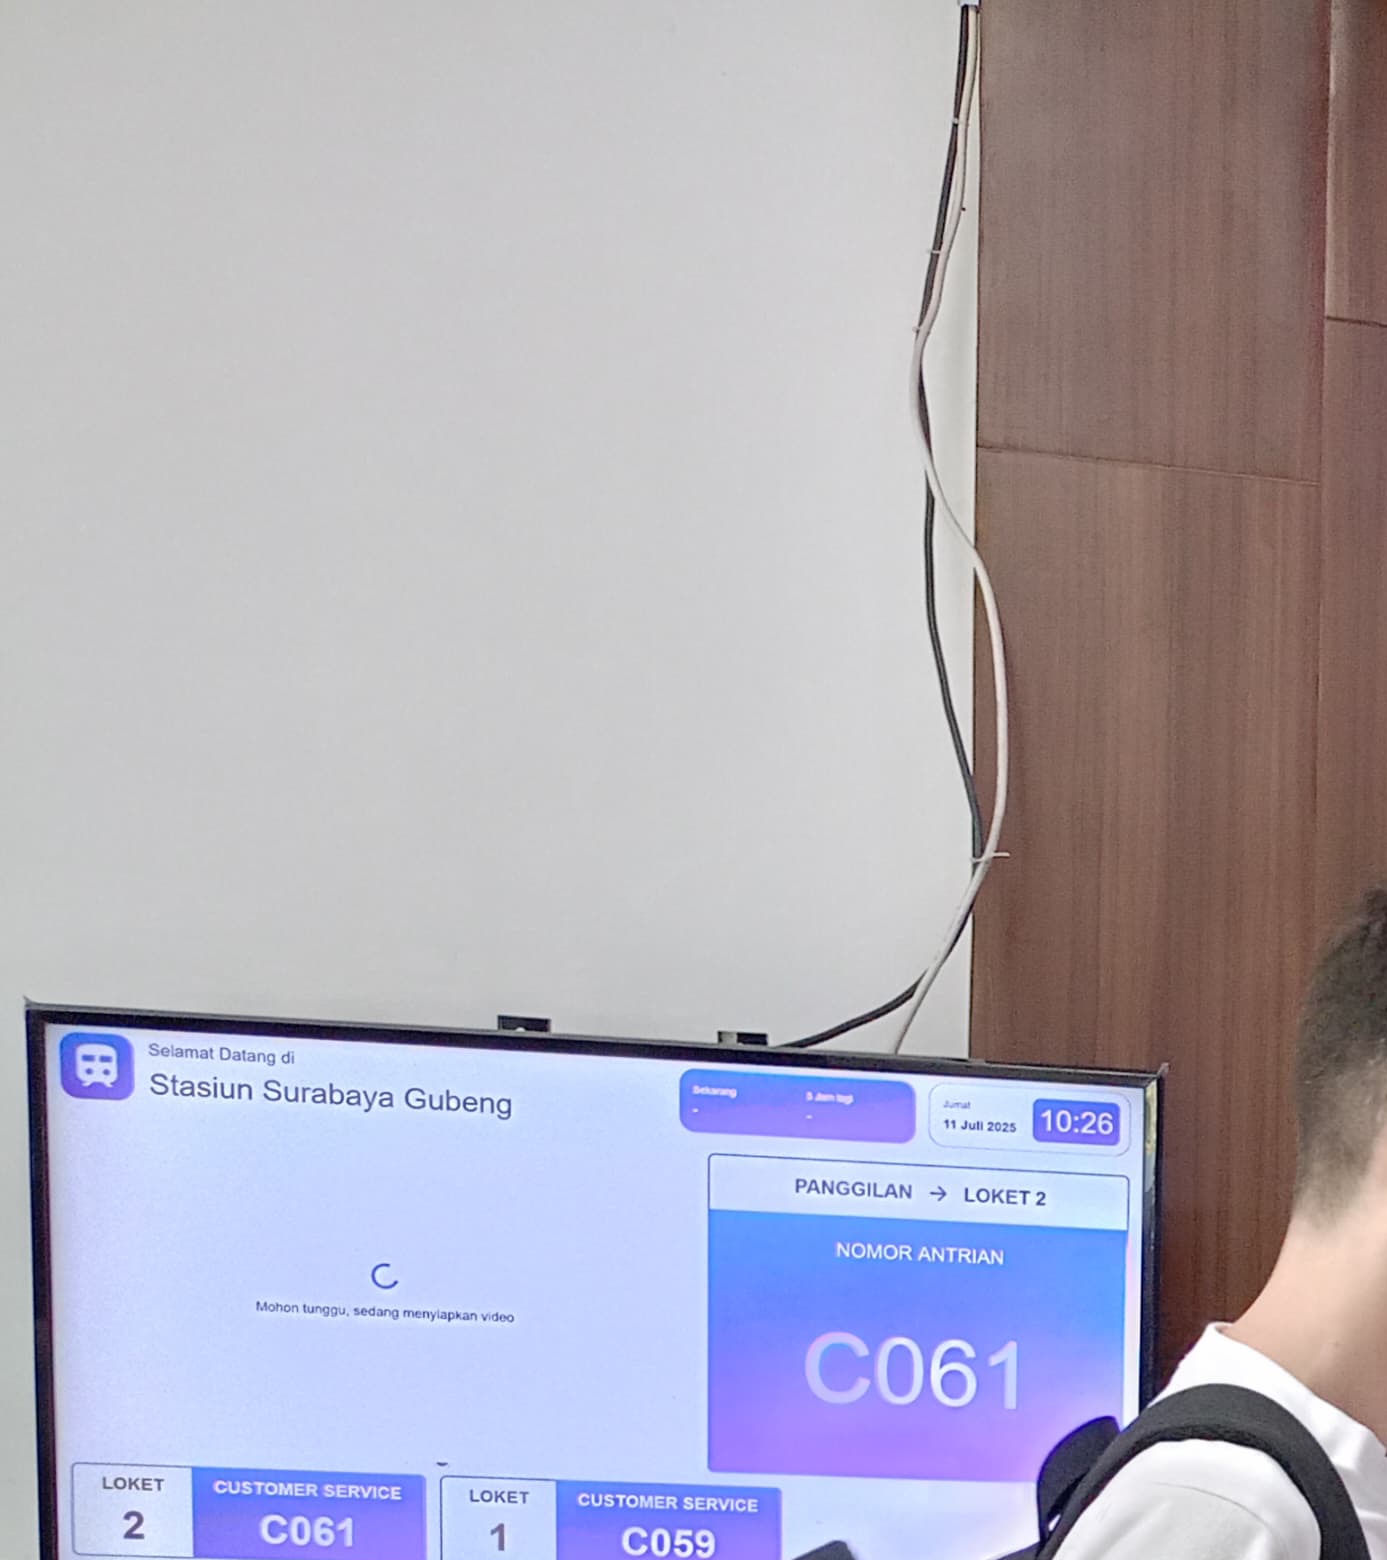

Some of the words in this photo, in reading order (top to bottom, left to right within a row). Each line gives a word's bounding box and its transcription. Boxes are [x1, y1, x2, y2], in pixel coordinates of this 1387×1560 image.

[148, 1042, 215, 1061] Selamat
[219, 1046, 277, 1067] Datang
[280, 1049, 296, 1065] di
[150, 1072, 253, 1102] Stasiun
[263, 1079, 394, 1113] Surabaya
[404, 1087, 513, 1121] Gubeng
[943, 1119, 957, 1130] 11
[959, 1119, 983, 1132] Juli
[986, 1121, 1017, 1134] 2025
[1040, 1109, 1115, 1136] 10:26
[794, 1177, 914, 1200] PANGGILAN
[963, 1187, 1031, 1207] LOKET
[1035, 1191, 1047, 1207] 2
[835, 1242, 913, 1261] NOMOR
[917, 1246, 1005, 1266] ANTRIAN
[256, 1300, 299, 1315] Mohon
[303, 1303, 350, 1319] tunggu,
[353, 1305, 400, 1321] sedang
[403, 1308, 477, 1323] menyiapkan
[480, 1310, 516, 1324] video
[804, 1331, 1020, 1411] C061
[102, 1476, 165, 1493] LOKET
[212, 1480, 319, 1499] CUSTOMER
[323, 1483, 403, 1501] SERVICE
[469, 1489, 530, 1506] LOKET
[577, 1492, 679, 1511] CUSTOMER
[682, 1495, 759, 1513] SERVICE
[122, 1511, 146, 1541] 2
[259, 1514, 355, 1548] C061
[488, 1524, 507, 1552] 1
[621, 1527, 716, 1560] C059
